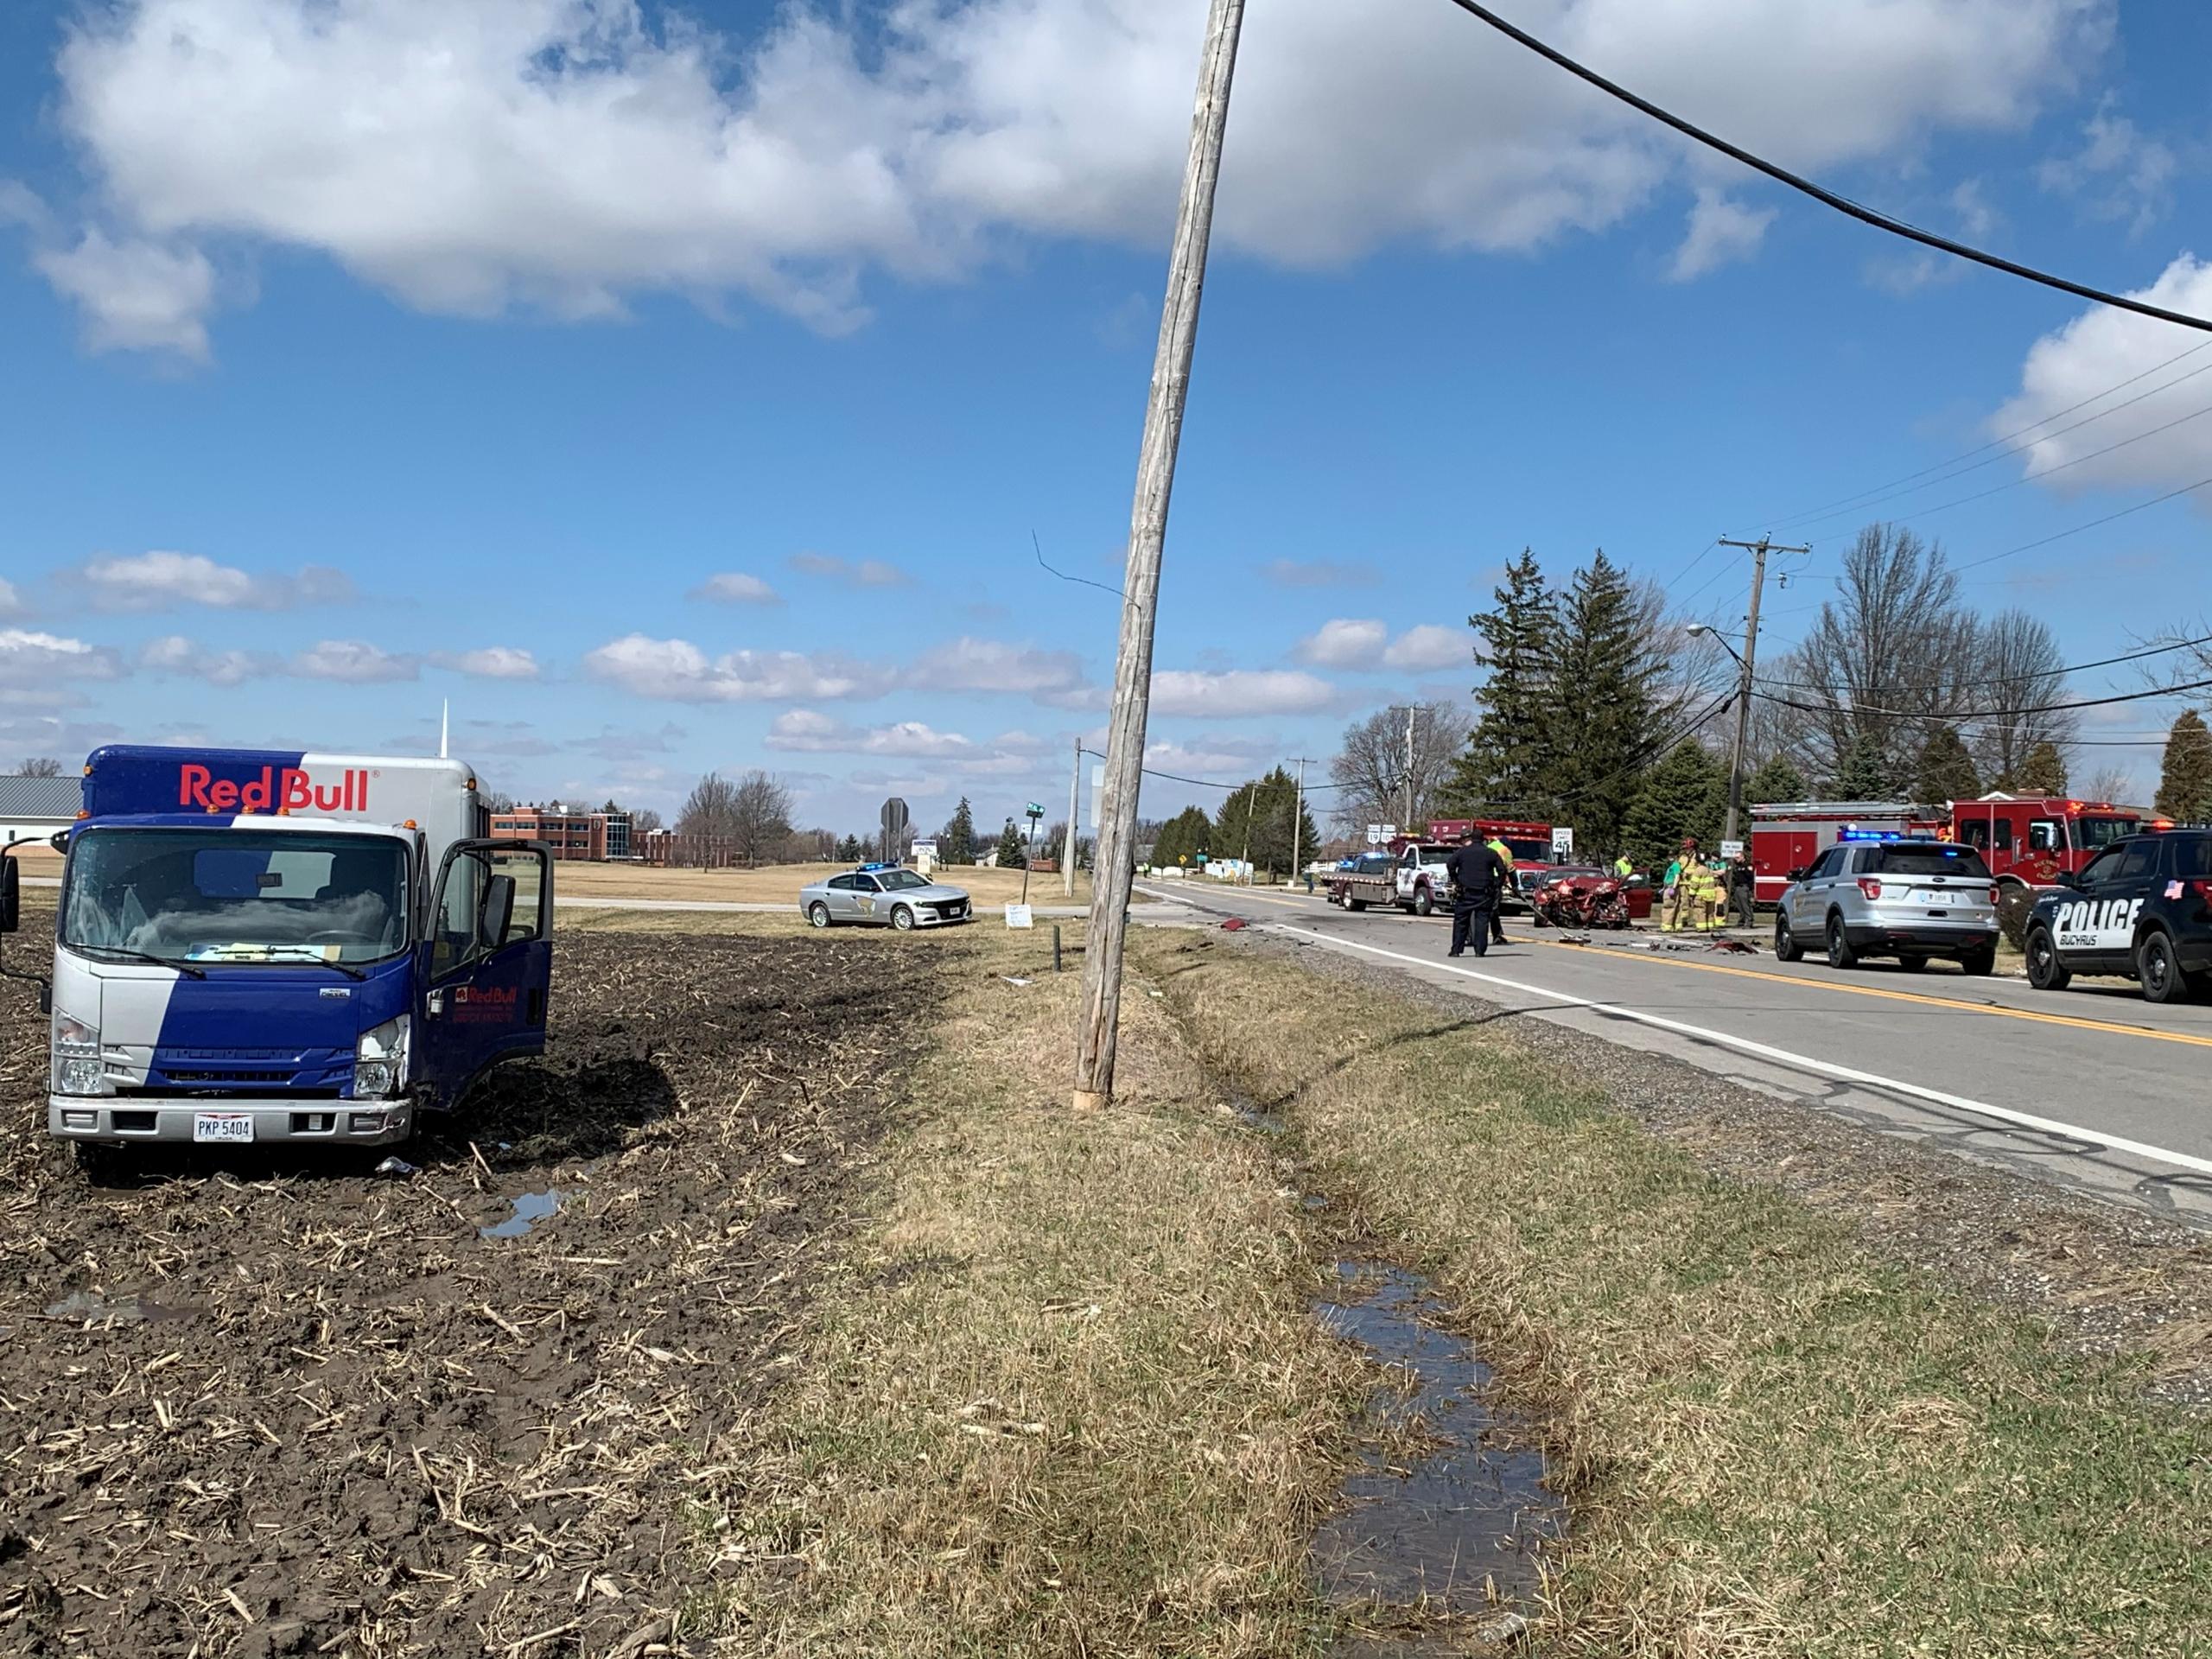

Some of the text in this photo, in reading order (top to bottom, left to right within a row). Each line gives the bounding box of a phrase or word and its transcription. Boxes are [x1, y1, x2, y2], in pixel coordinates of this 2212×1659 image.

[180, 764, 368, 811] Red Bull
[1555, 840, 1569, 850] 45
[2054, 899, 2145, 931] POLICE
[2059, 934, 2097, 946] BUCYRUS
[469, 986, 517, 1003] Red Bull
[199, 1121, 249, 1135] PKP 5404
